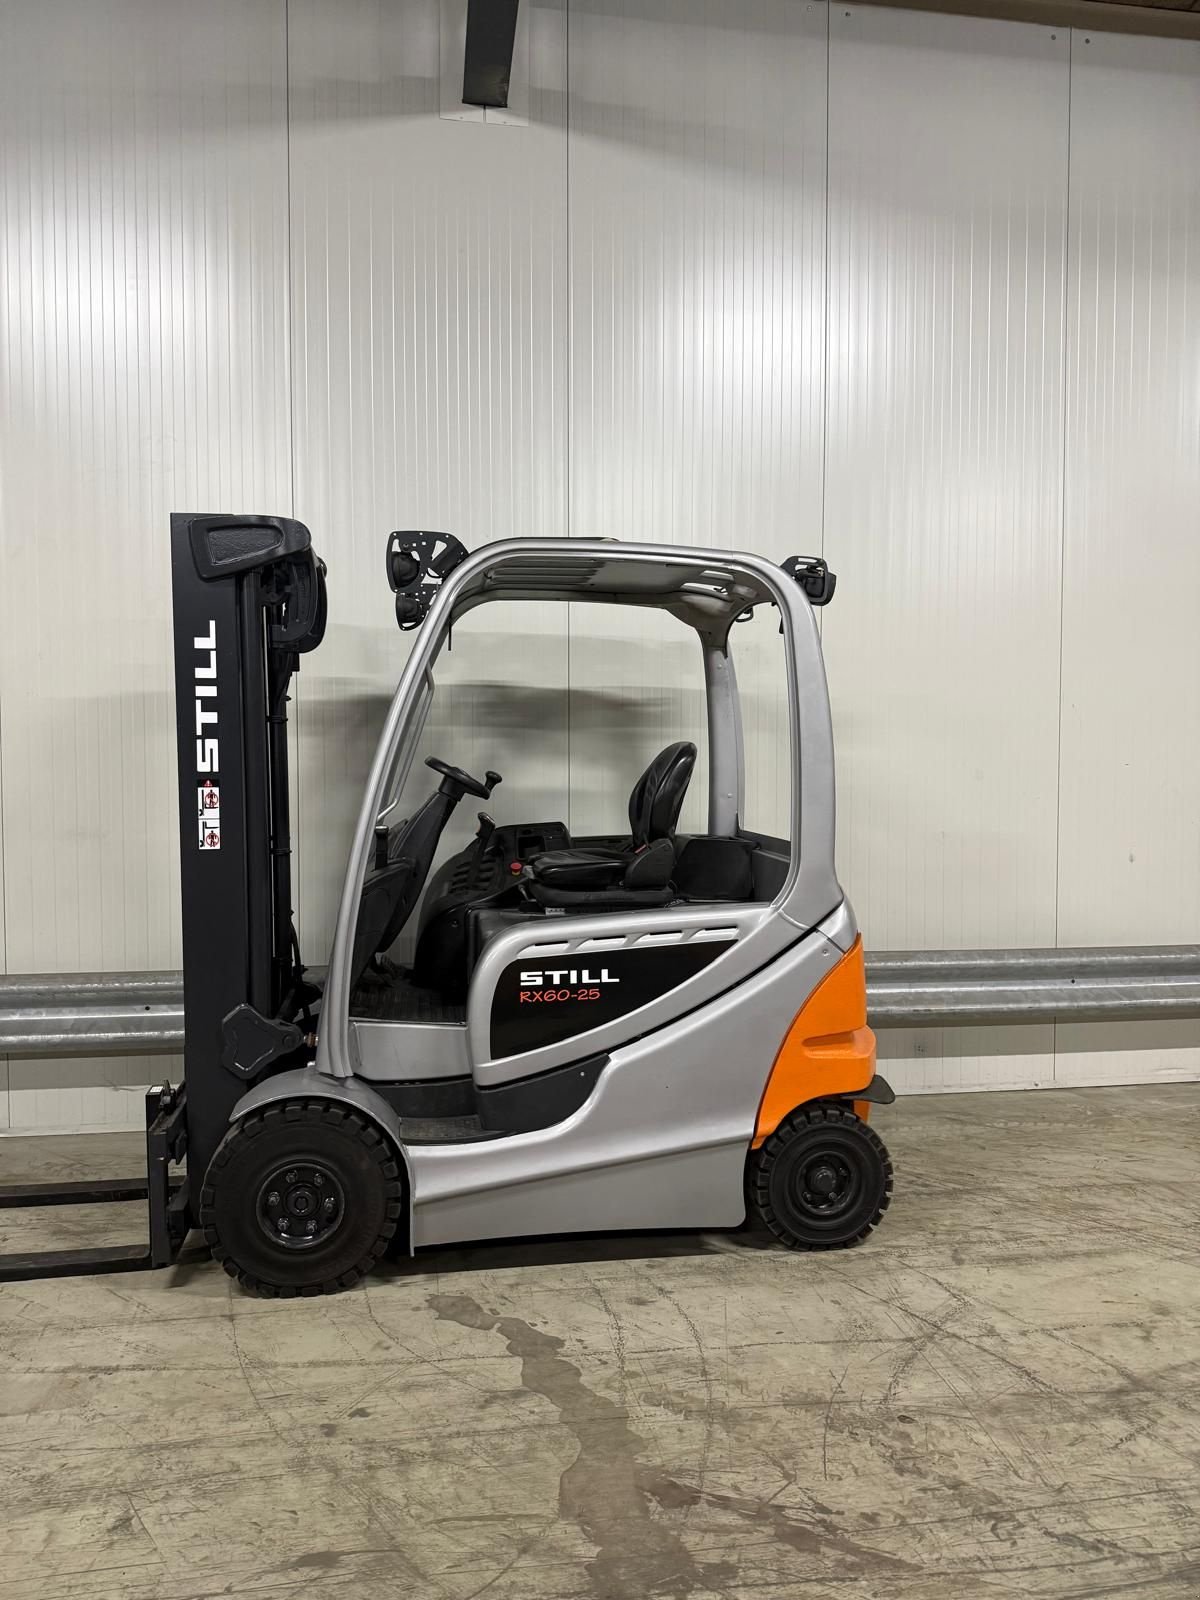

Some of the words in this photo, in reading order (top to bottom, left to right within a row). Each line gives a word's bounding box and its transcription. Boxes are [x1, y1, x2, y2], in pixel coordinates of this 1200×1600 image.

[193, 620, 219, 773] STILL
[520, 968, 620, 986] STILL
[519, 988, 601, 1003] RX60-25
